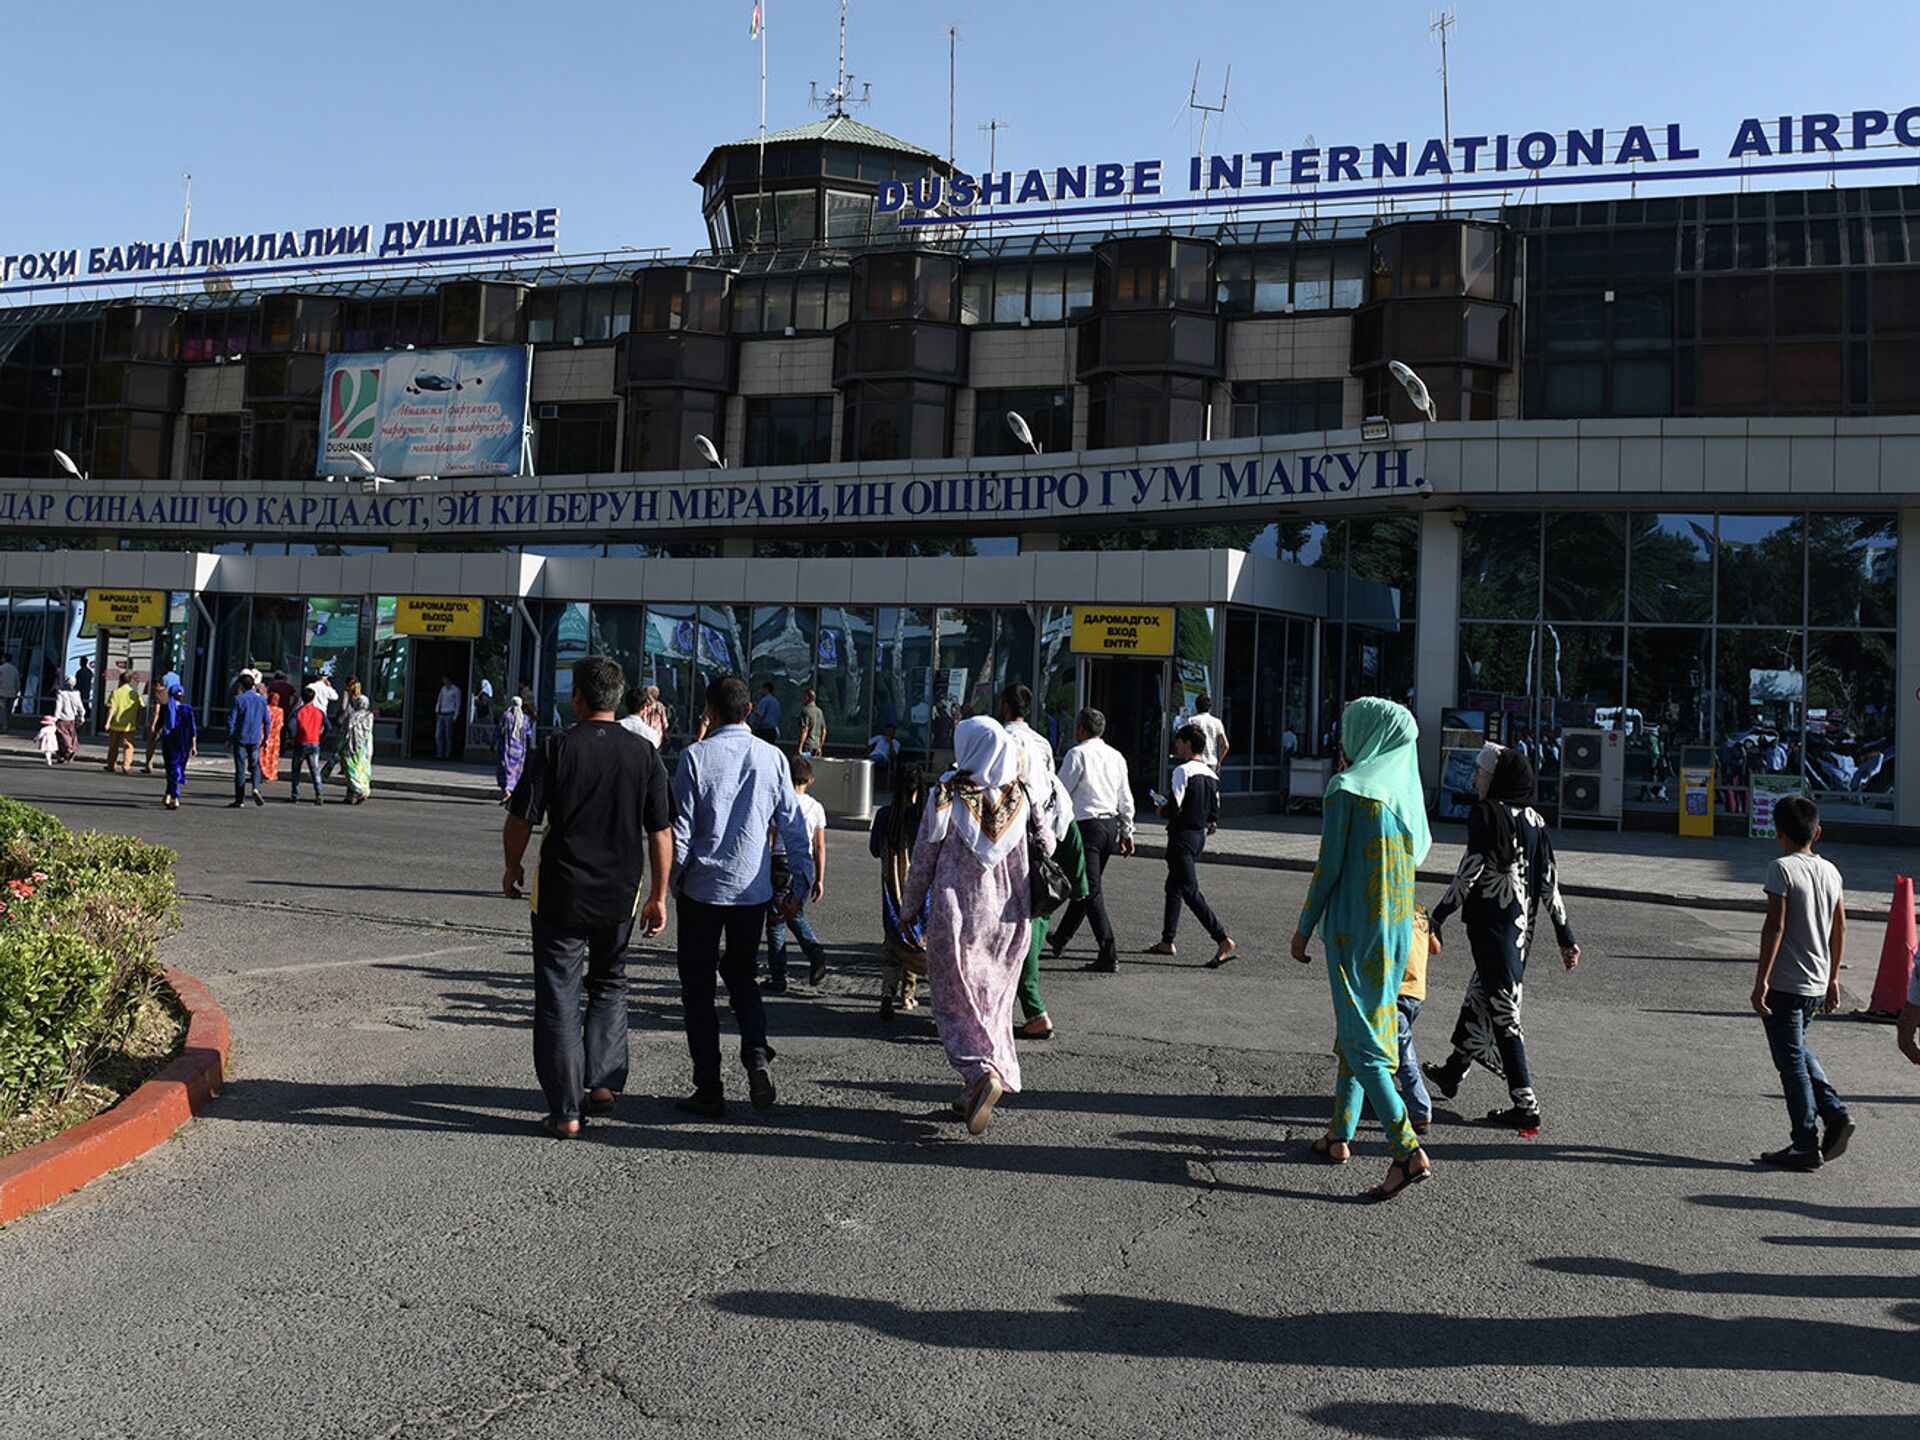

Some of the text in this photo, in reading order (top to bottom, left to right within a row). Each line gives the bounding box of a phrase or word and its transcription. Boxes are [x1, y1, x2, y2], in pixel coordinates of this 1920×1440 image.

[877, 160, 1163, 212] DUSHANBE
[1190, 123, 1700, 191] INTERNATIONAL
[0, 207, 558, 282] ГОҲИ БАЙНАЛМИЛАЛИИ ДУШАНБЕ
[326, 442, 373, 453] DUSHANBE
[0, 493, 55, 520] ДАР
[65, 494, 198, 524] СИНААШ
[255, 495, 430, 531] КАРДААСТ,
[437, 489, 480, 526] ЭЙ
[489, 493, 538, 525] КИ
[544, 489, 660, 525] БЕРУН
[833, 482, 895, 517] ИН
[1100, 464, 1203, 506] ГУМ
[1217, 448, 1426, 499] МАКУН.
[111, 604, 139, 613] ВЫХОД
[115, 614, 133, 622] EXIT
[421, 612, 454, 623] ВЫХОД
[1083, 614, 1160, 627] ДАРОМАДГОҲ
[426, 624, 447, 632] EXIT
[1107, 627, 1137, 638] ВХОД
[1103, 638, 1138, 648] ENTRY
